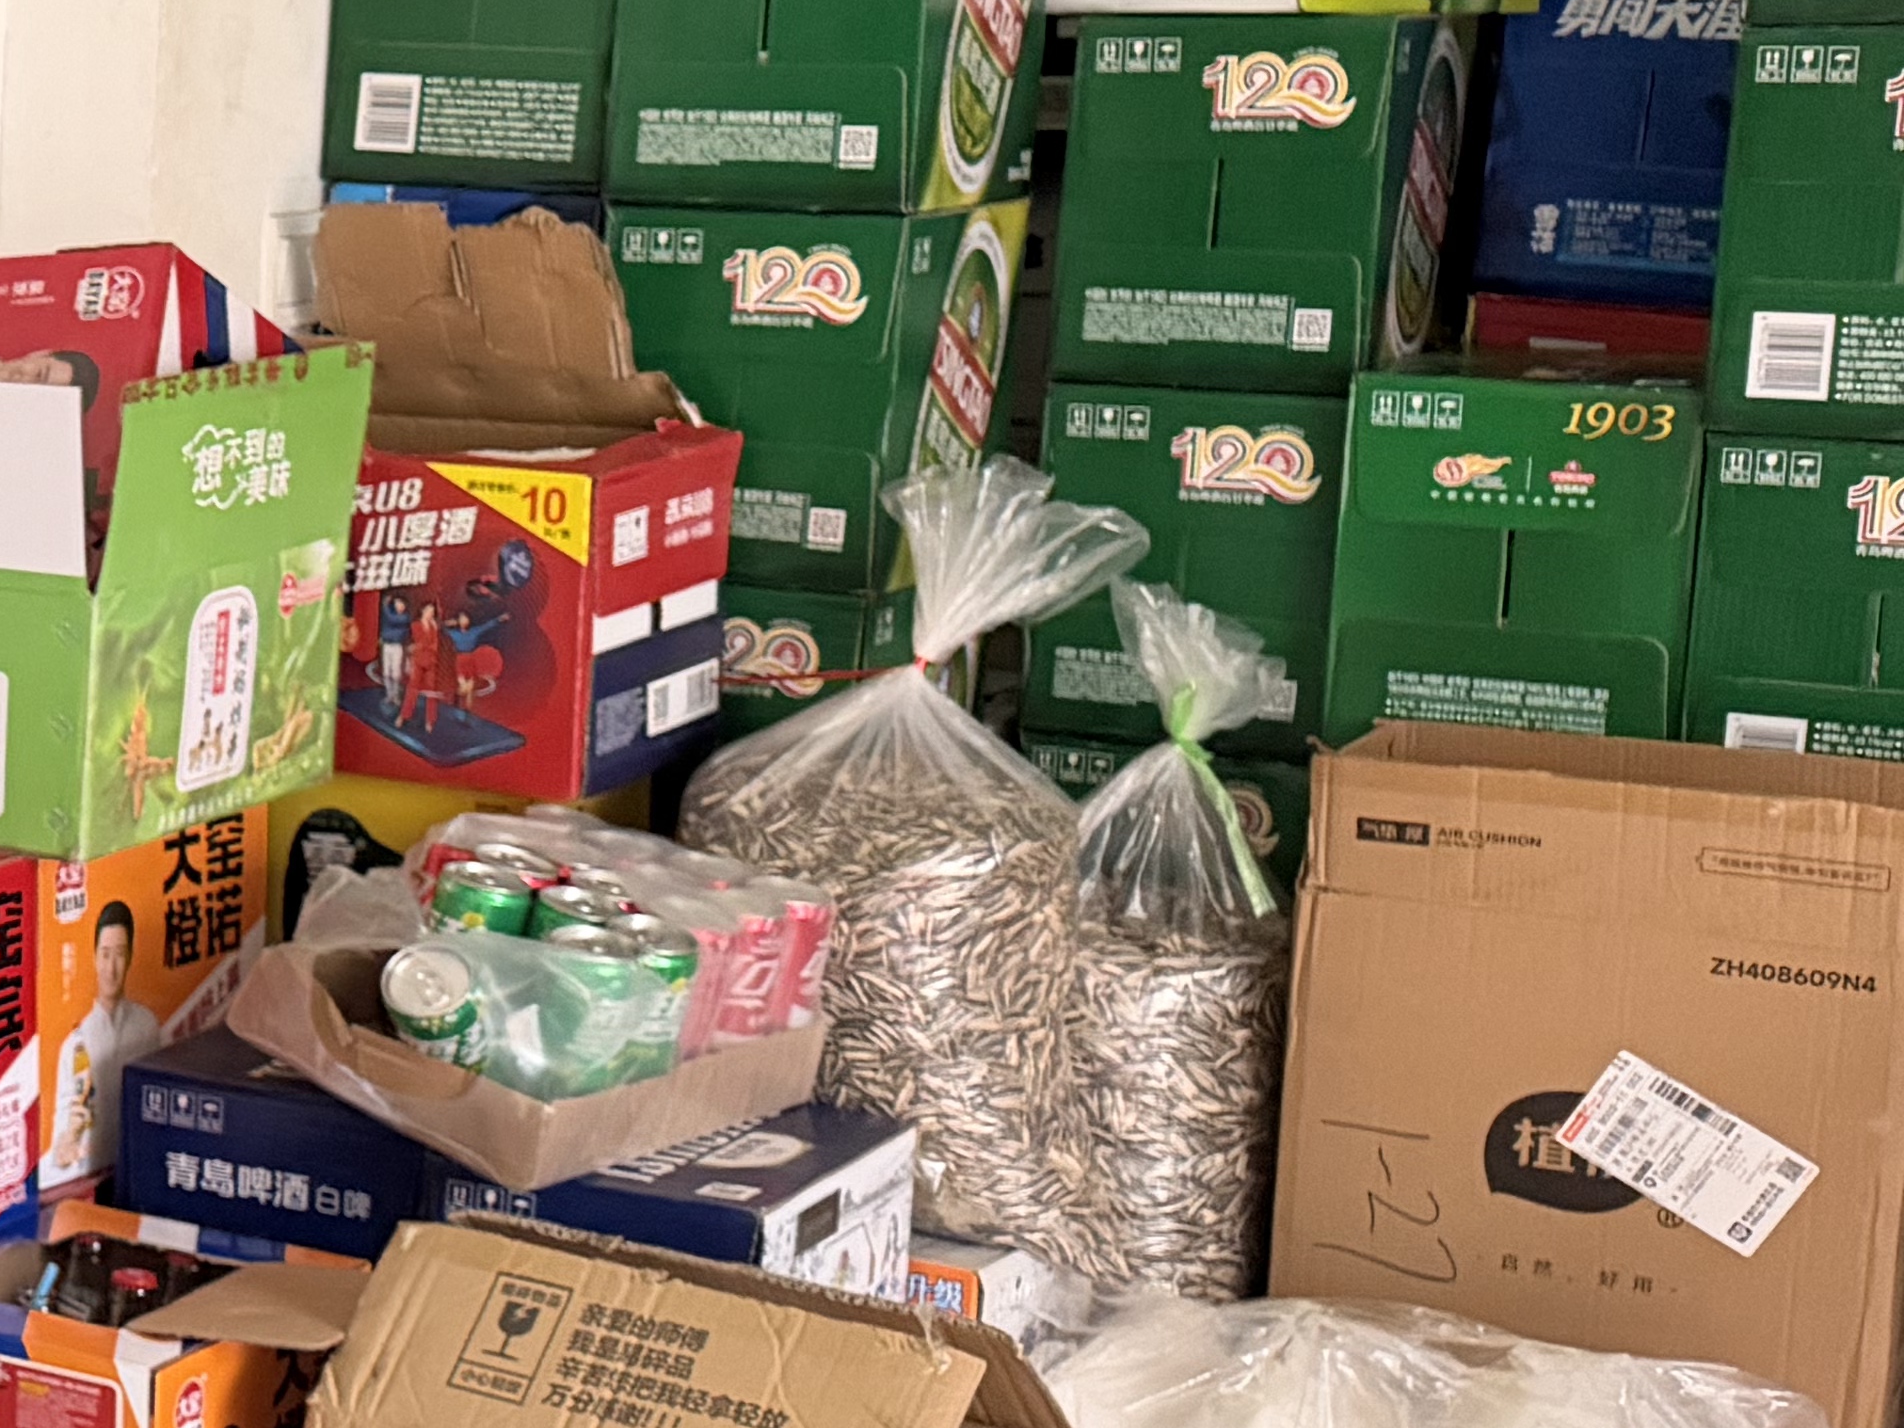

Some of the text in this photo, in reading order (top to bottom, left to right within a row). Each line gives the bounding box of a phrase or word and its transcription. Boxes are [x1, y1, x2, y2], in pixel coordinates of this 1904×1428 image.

[1202, 50, 1358, 129] 120
[722, 245, 870, 325] 120
[1562, 400, 1677, 442] 1903
[192, 427, 287, 494] 想不到的
[243, 459, 292, 507] 美味
[1169, 423, 1323, 505] 120
[358, 505, 479, 553] 小度酒
[522, 486, 568, 526] 10
[345, 550, 433, 594] 滋味
[162, 886, 244, 970] 橙诺
[1710, 955, 1880, 995] ZH408609N4
[164, 1150, 373, 1222] 青岛啤酒 白啤
[580, 1302, 711, 1353] 亲爱的师傅
